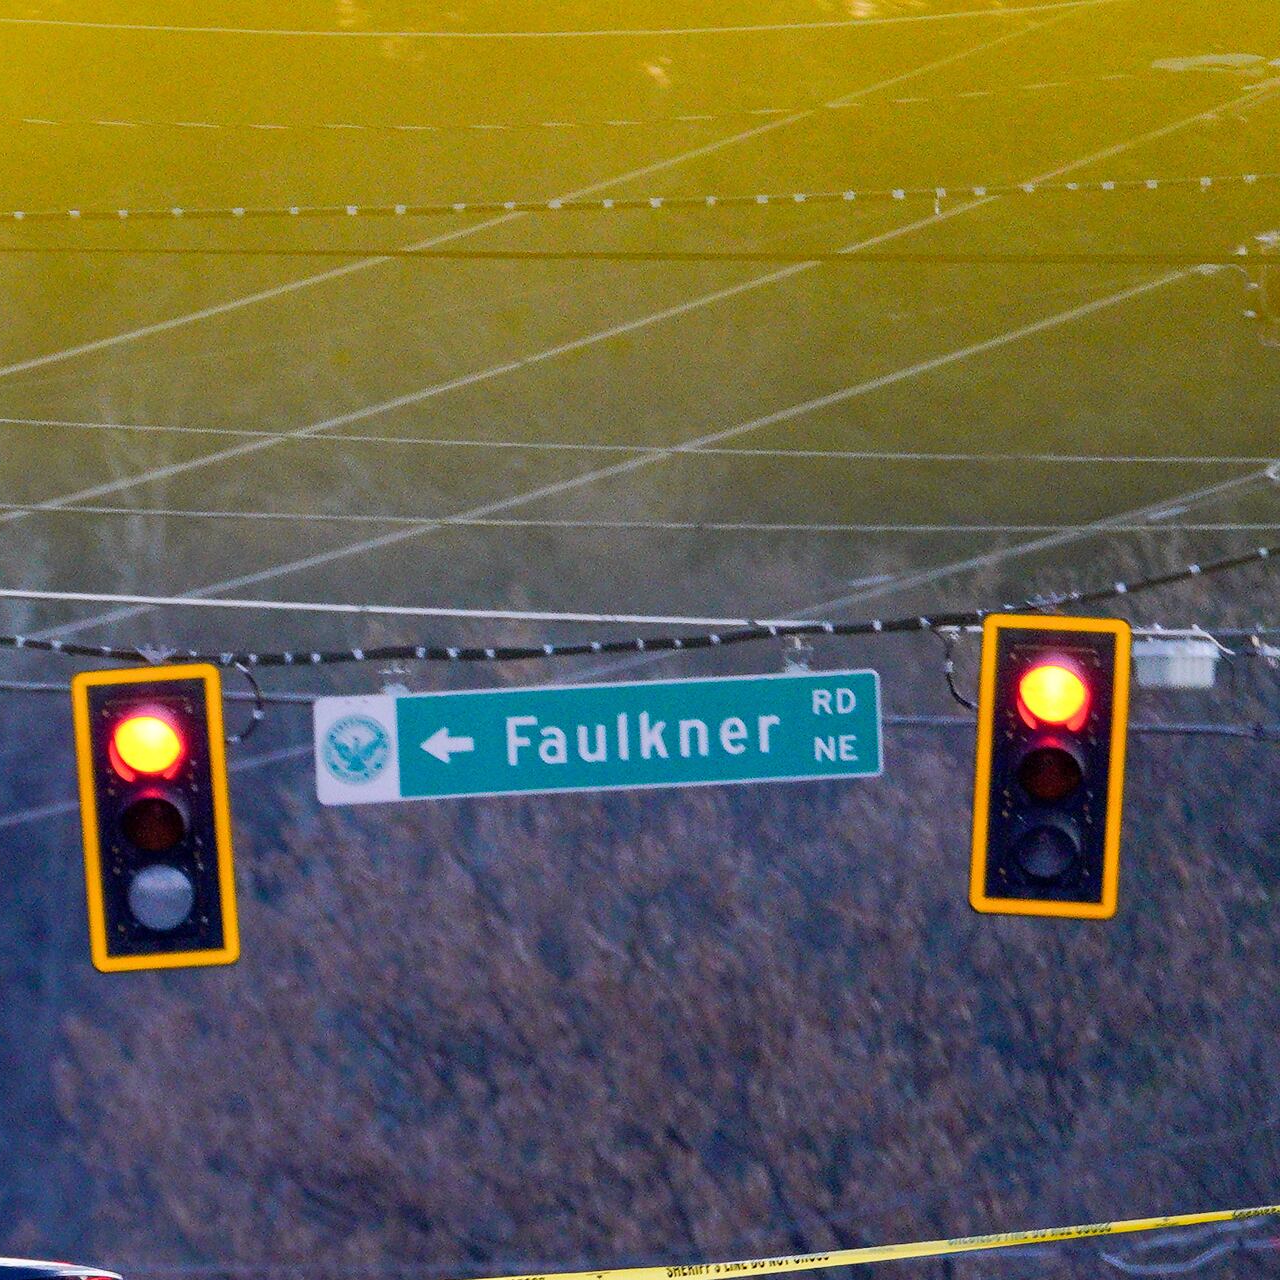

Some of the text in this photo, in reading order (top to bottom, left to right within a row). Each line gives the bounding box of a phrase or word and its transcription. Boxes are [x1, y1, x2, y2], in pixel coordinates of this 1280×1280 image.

[811, 687, 857, 716] RD
[505, 710, 782, 766] Faulkner
[814, 734, 858, 763] NE
